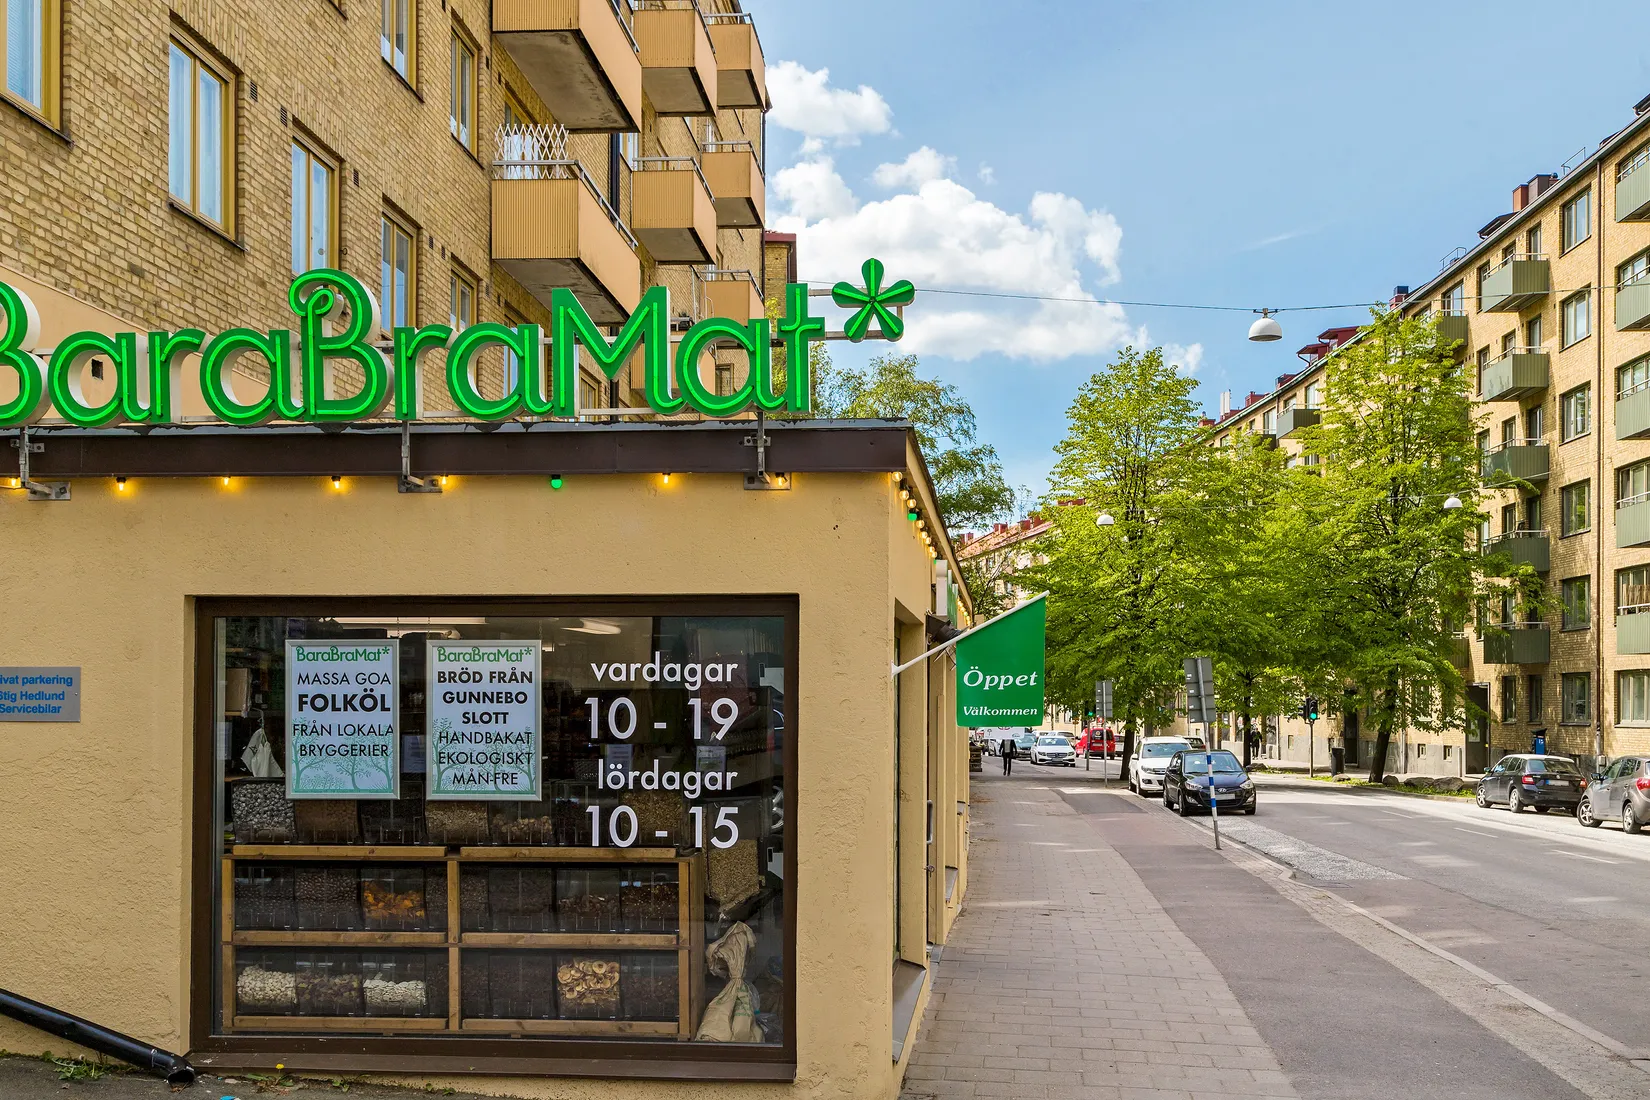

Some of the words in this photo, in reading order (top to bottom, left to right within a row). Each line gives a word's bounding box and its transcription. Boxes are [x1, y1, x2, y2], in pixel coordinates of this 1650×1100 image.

[437, 667, 483, 684] BRÖD
[489, 667, 533, 684] FRÅN
[590, 651, 739, 691] vardagar
[963, 666, 1039, 690] Öppet
[22, 675, 73, 687] parkering
[297, 672, 350, 685] MASSA
[355, 672, 391, 685] GOA
[20, 691, 65, 701] Hedlund
[298, 688, 391, 712] FOLKÖL
[442, 691, 528, 704] GUNNEBO
[0, 704, 62, 714] Servicebilar
[963, 706, 1038, 716] Välkommen
[462, 711, 509, 724] SLOTT
[584, 697, 637, 740] 10
[687, 697, 739, 741] 19
[293, 720, 332, 737] FRÅN
[338, 724, 394, 737] LOKALA
[439, 732, 532, 744] HANDBAKAT
[300, 744, 389, 757] BRYGGERIER
[439, 751, 533, 765] EKOLOGISKT
[452, 768, 518, 785] MÅN-FRE
[598, 758, 739, 799] lördagar
[585, 805, 638, 848] 10
[688, 806, 739, 849] 15
